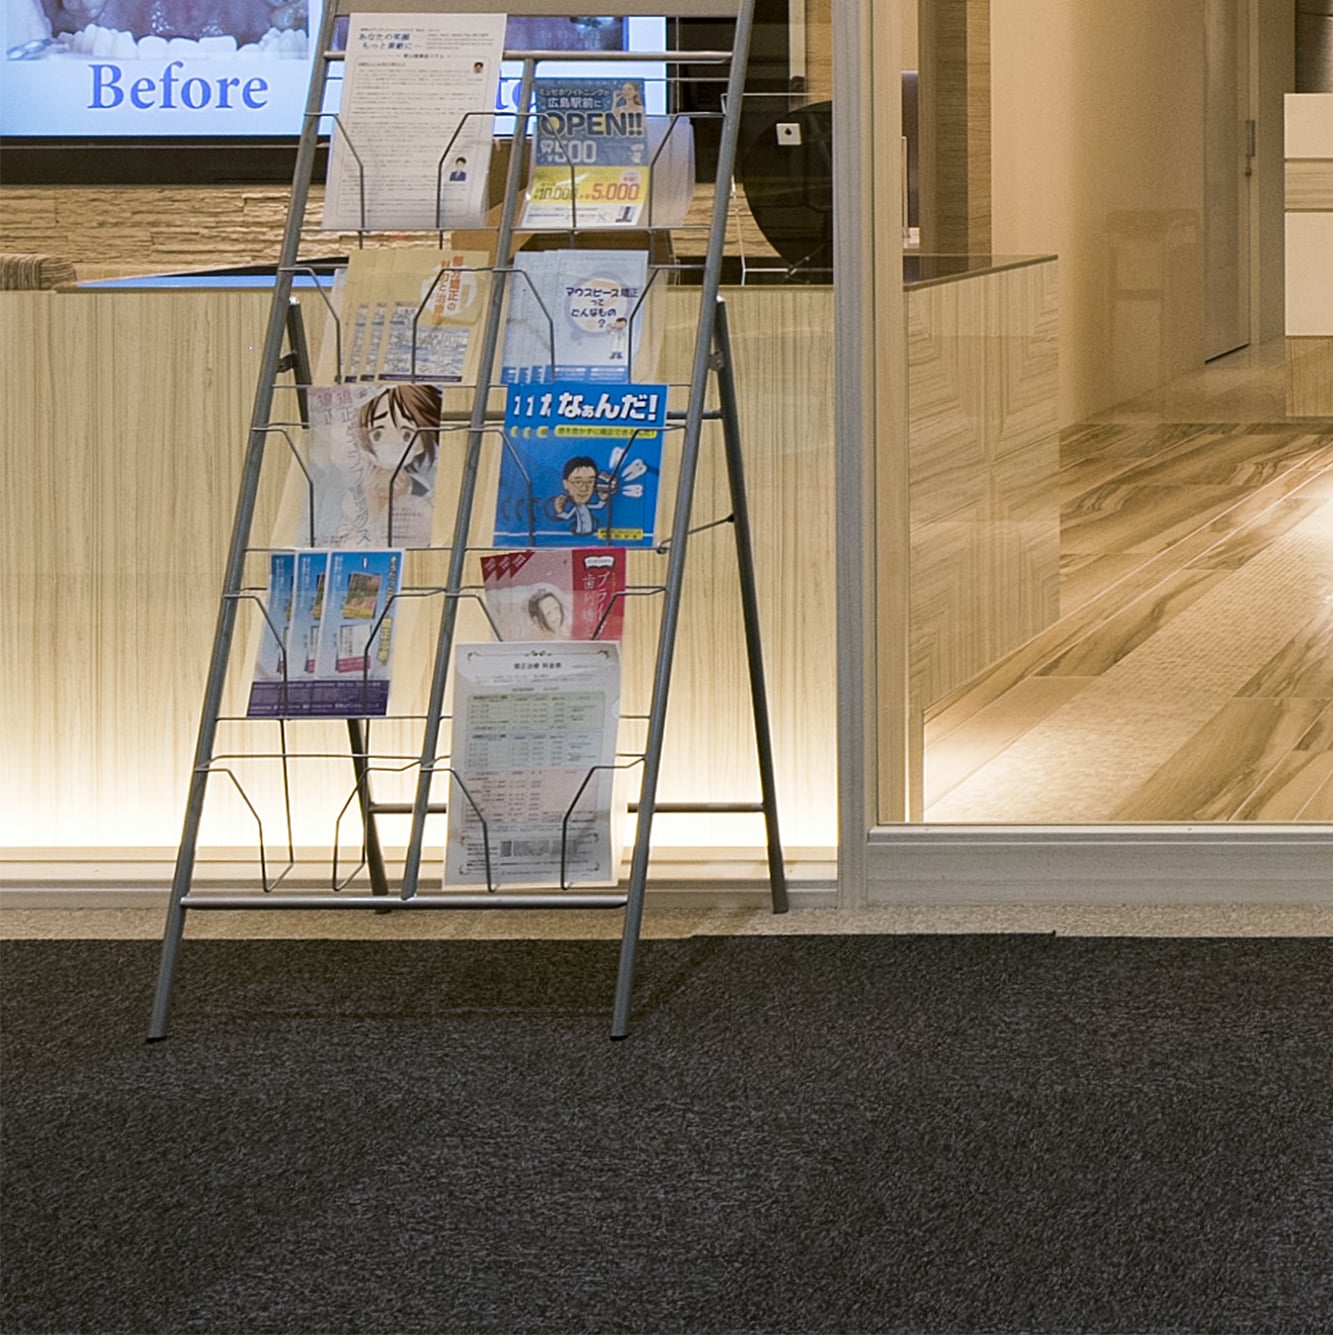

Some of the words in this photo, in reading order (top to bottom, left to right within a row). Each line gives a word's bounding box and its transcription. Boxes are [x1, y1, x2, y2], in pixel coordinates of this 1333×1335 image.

[87, 61, 269, 110] Before
[540, 110, 644, 138] OPEN!!
[557, 392, 658, 421] なぁんだ!
